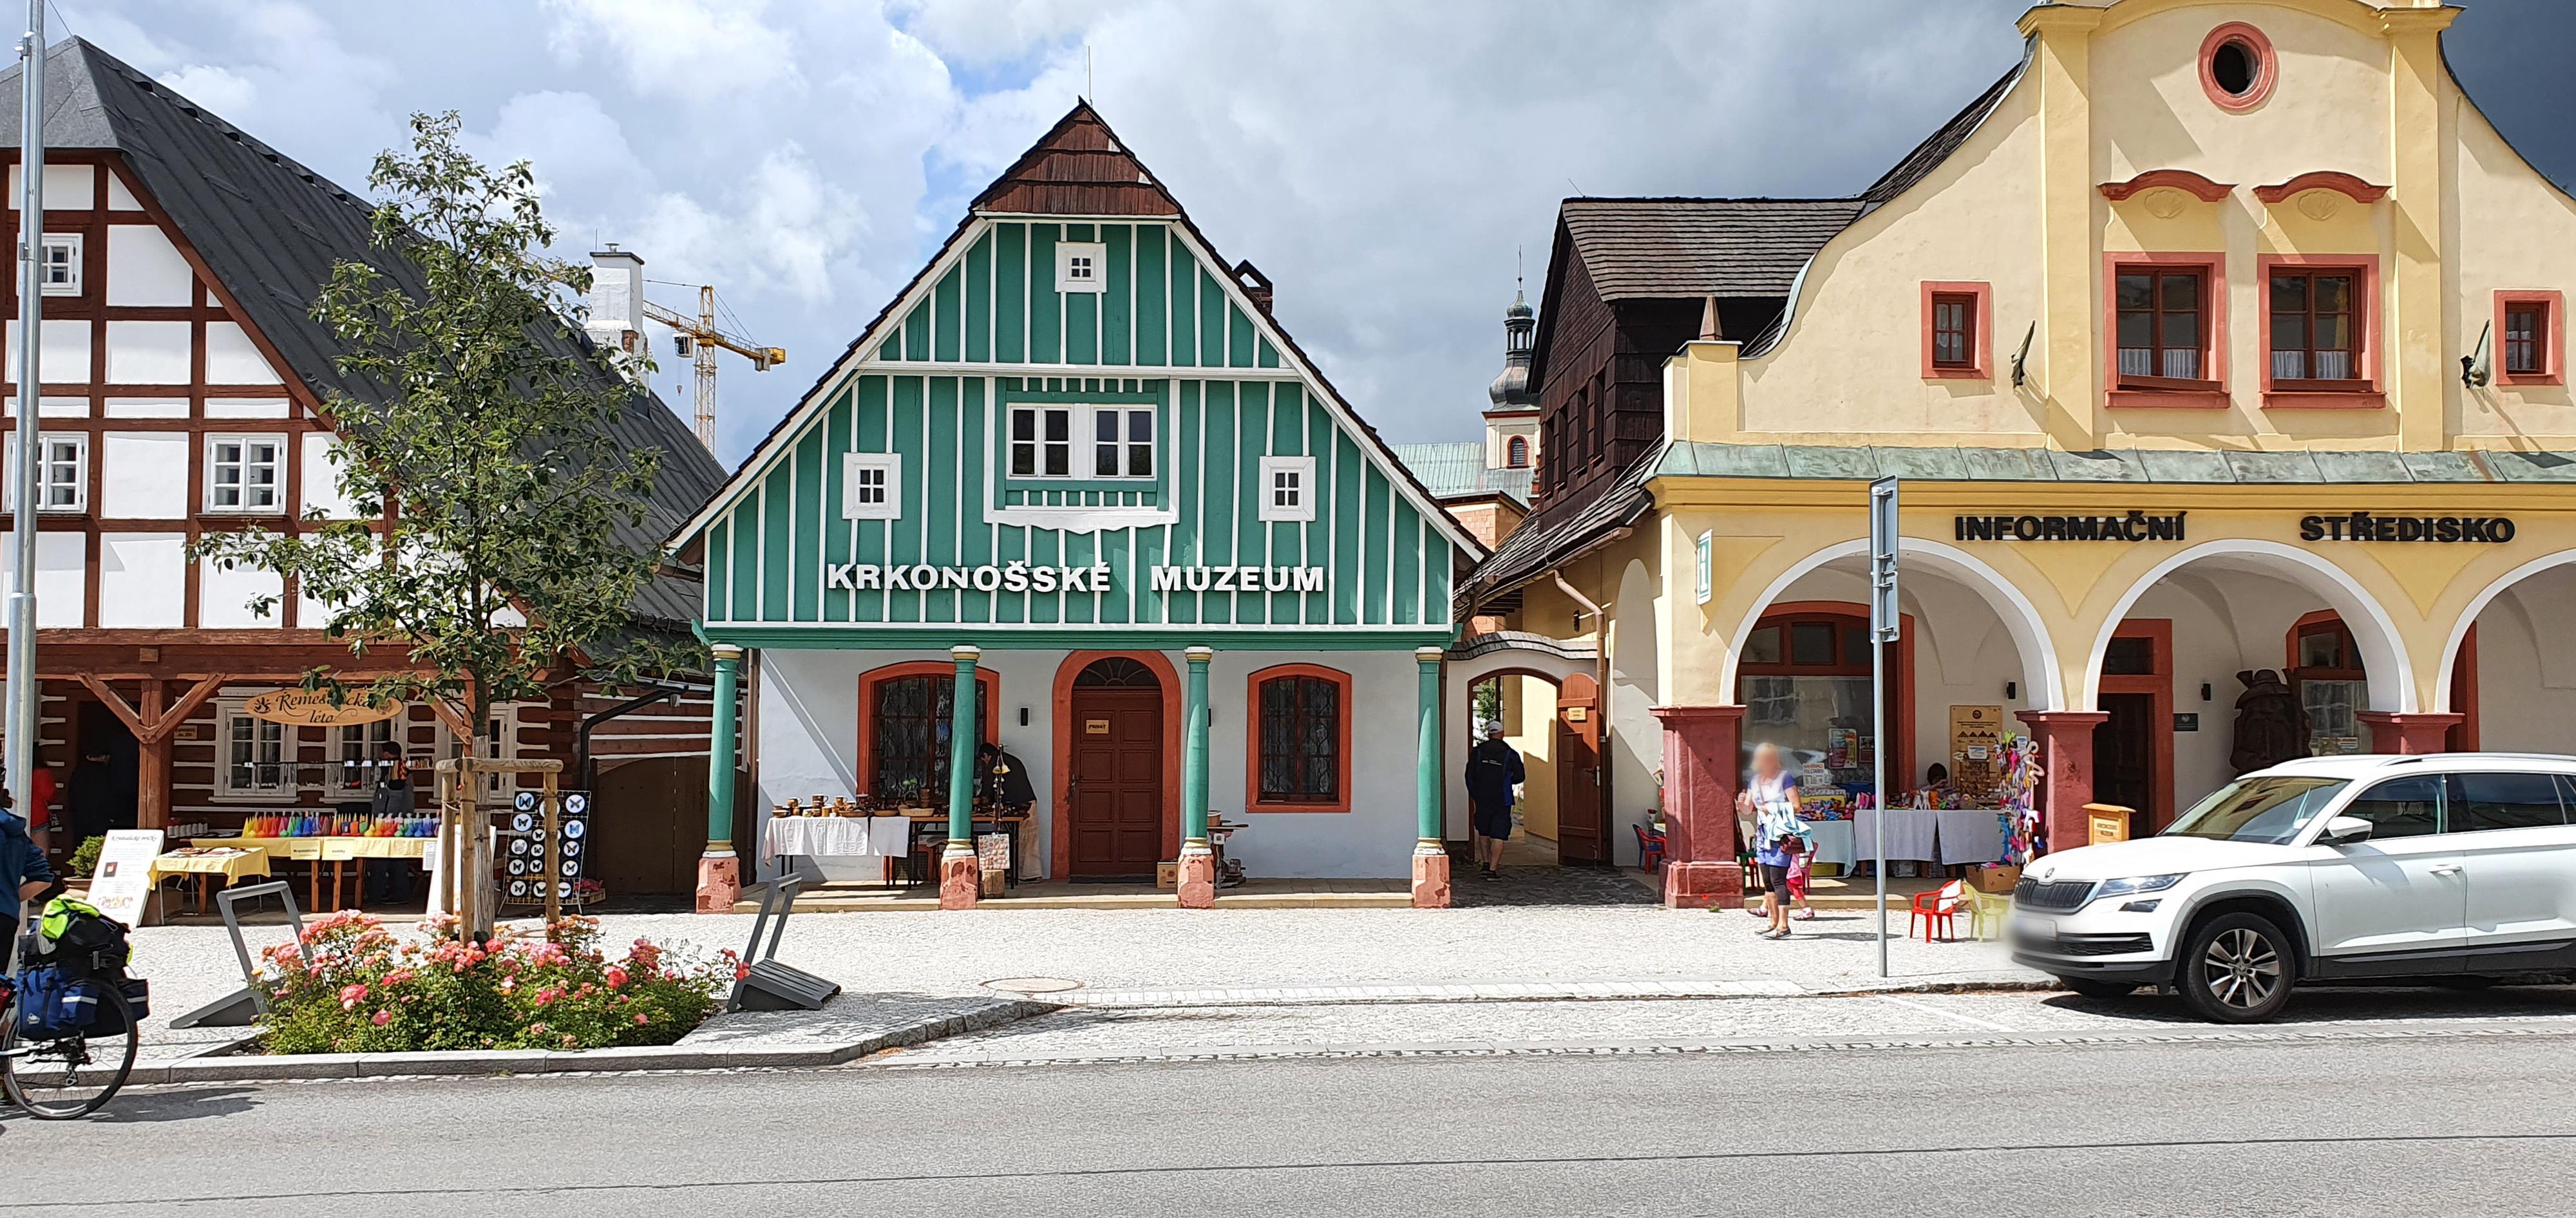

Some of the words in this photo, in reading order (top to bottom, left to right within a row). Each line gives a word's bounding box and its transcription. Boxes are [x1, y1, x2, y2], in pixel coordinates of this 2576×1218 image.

[1955, 511, 2188, 542] INFORMAČNÍ
[2300, 511, 2515, 543] STŘEDISKO
[828, 560, 1111, 593] KRKONOŠSKÉ
[1150, 565, 1324, 592] MUZEUM
[275, 691, 372, 712] Řemesck
[309, 709, 336, 724] léto
